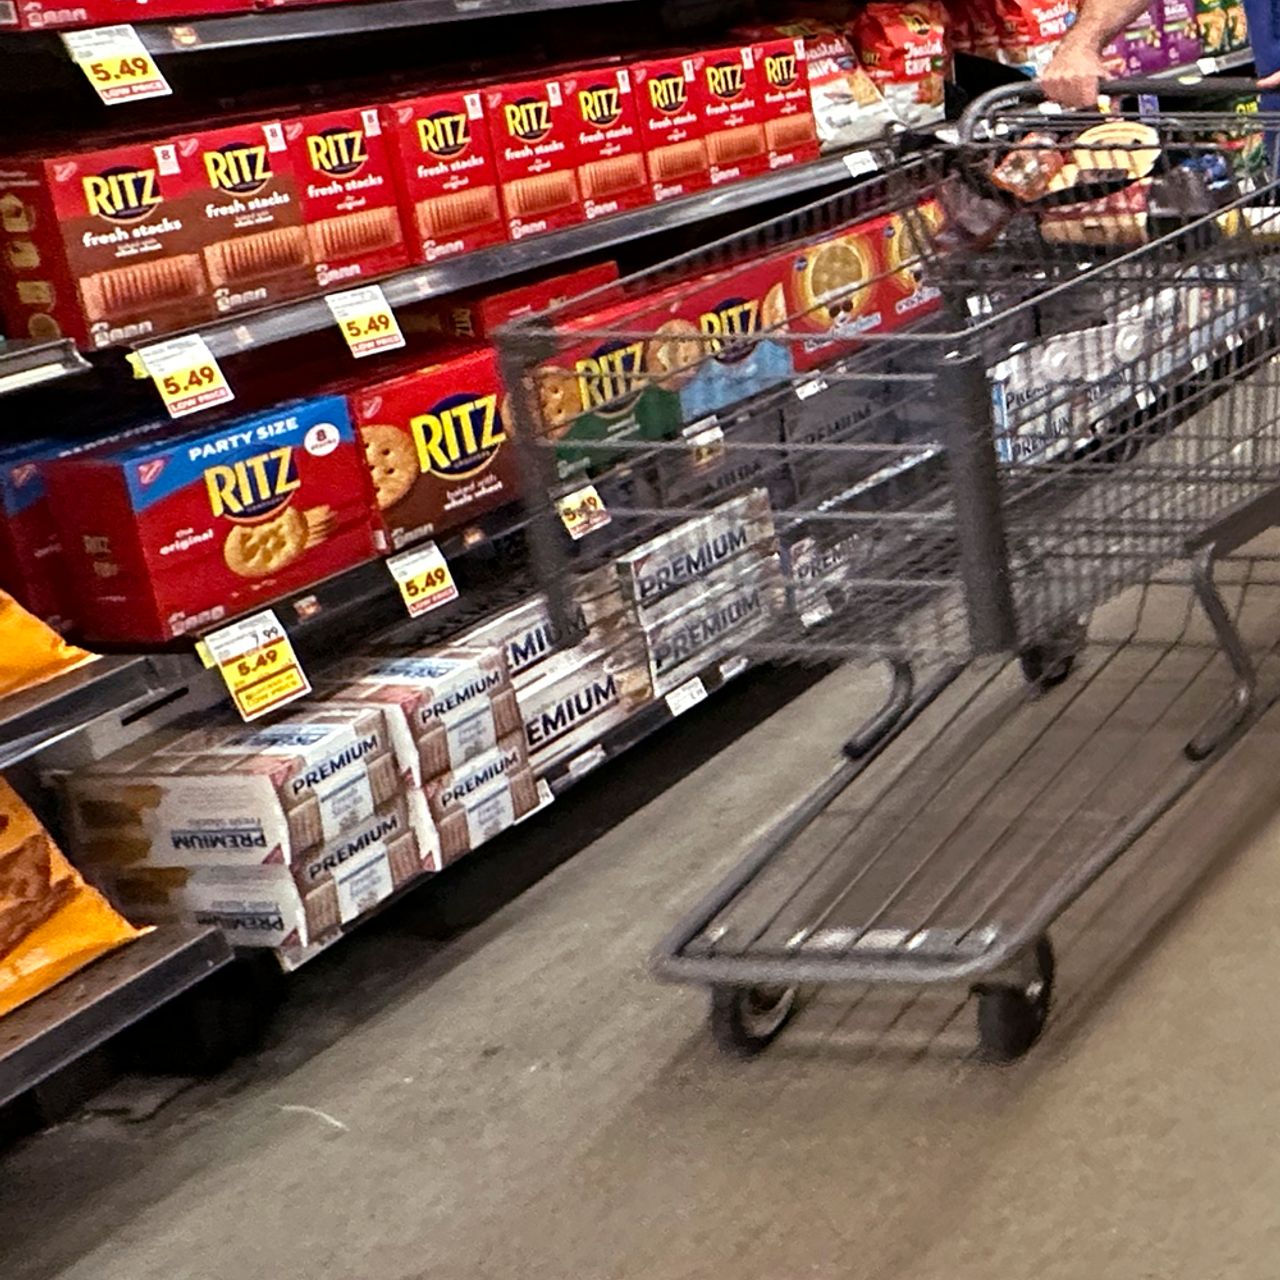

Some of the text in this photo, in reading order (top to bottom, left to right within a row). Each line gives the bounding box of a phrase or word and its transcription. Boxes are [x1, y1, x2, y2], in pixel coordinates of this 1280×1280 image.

[90, 57, 152, 82] 5.49
[82, 169, 164, 217] RITZ
[82, 217, 183, 250] fresh stacks
[345, 311, 392, 337] 5.49
[162, 364, 217, 396] 5.49
[187, 417, 301, 462] PARTY SIZE
[405, 566, 446, 597] 5.49
[637, 526, 748, 601] PREMIUM
[421, 670, 502, 725] PREMIUM
[291, 734, 379, 797] PREMIUM
[441, 751, 520, 808] PREMIUM
[308, 815, 398, 881] PREMIUM
